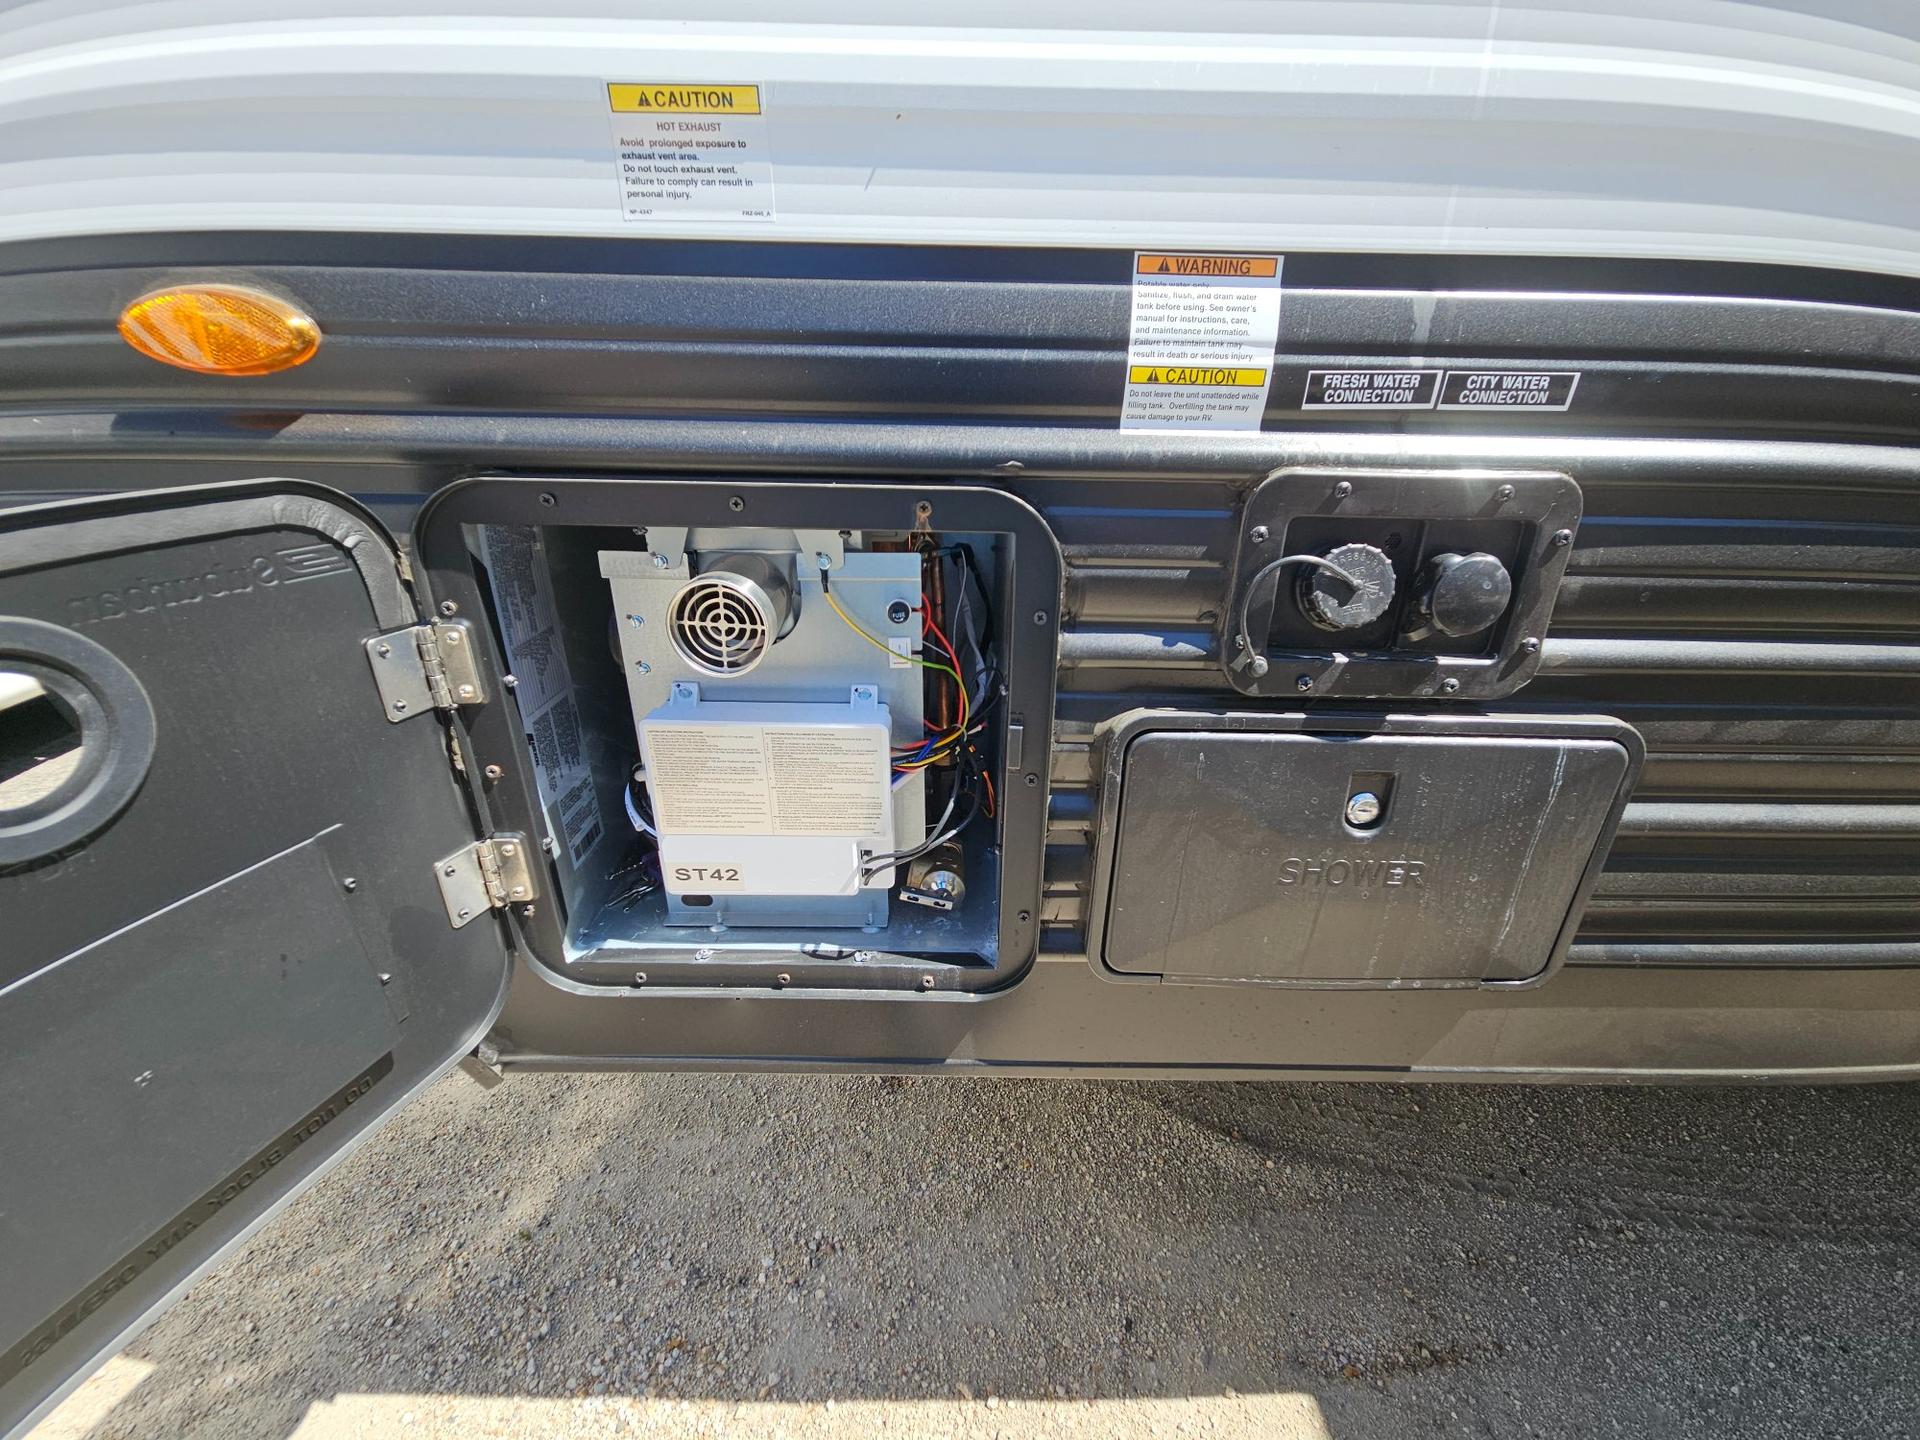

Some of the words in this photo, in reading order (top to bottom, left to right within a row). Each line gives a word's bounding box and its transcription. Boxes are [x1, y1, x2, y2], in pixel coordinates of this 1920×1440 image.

[654, 91, 733, 108] CAUTION
[657, 122, 674, 131] HOT
[679, 122, 722, 131] EXHAUST
[620, 138, 644, 146] Avoid
[649, 139, 692, 149] prolonged
[695, 140, 735, 149] exposure
[668, 178, 698, 187] comply
[627, 190, 663, 198] personal
[666, 190, 692, 200] injury.
[1176, 258, 1250, 274] WARNING
[1183, 303, 1207, 312] using.
[1180, 315, 1228, 324] instructions,
[1204, 328, 1250, 336] information.
[1227, 342, 1243, 350] may
[1166, 369, 1237, 384] CAUTION
[1323, 375, 1369, 388] FRESH
[1373, 375, 1420, 388] WATER
[1467, 376, 1499, 389] CITY
[1502, 376, 1550, 389] WATER
[1324, 390, 1414, 403] CONNECTION
[1459, 391, 1549, 404] CONNECTION
[1169, 402, 1204, 411] Overfilling
[1148, 413, 1174, 422] damage
[675, 868, 739, 881] ST42
[1276, 857, 1427, 887] SHOWER
